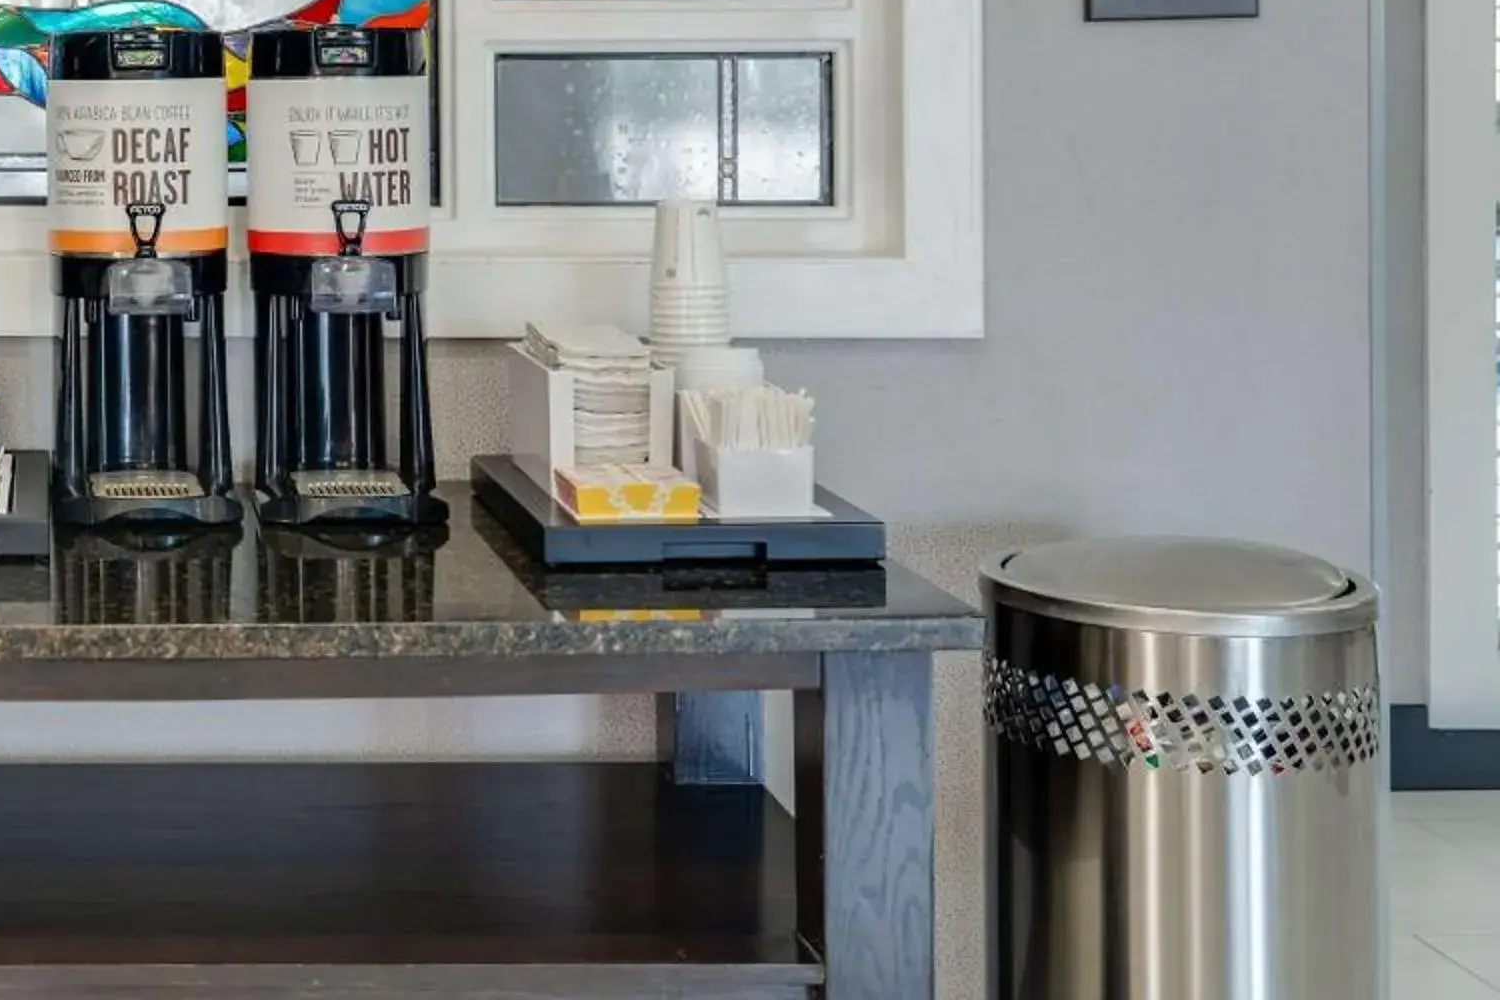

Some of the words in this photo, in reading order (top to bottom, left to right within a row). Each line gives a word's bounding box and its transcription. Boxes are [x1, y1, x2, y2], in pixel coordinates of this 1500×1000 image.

[112, 127, 191, 164] DECAF
[368, 127, 410, 165] HOT
[113, 169, 192, 206] ROAST
[339, 170, 411, 206] WATER
